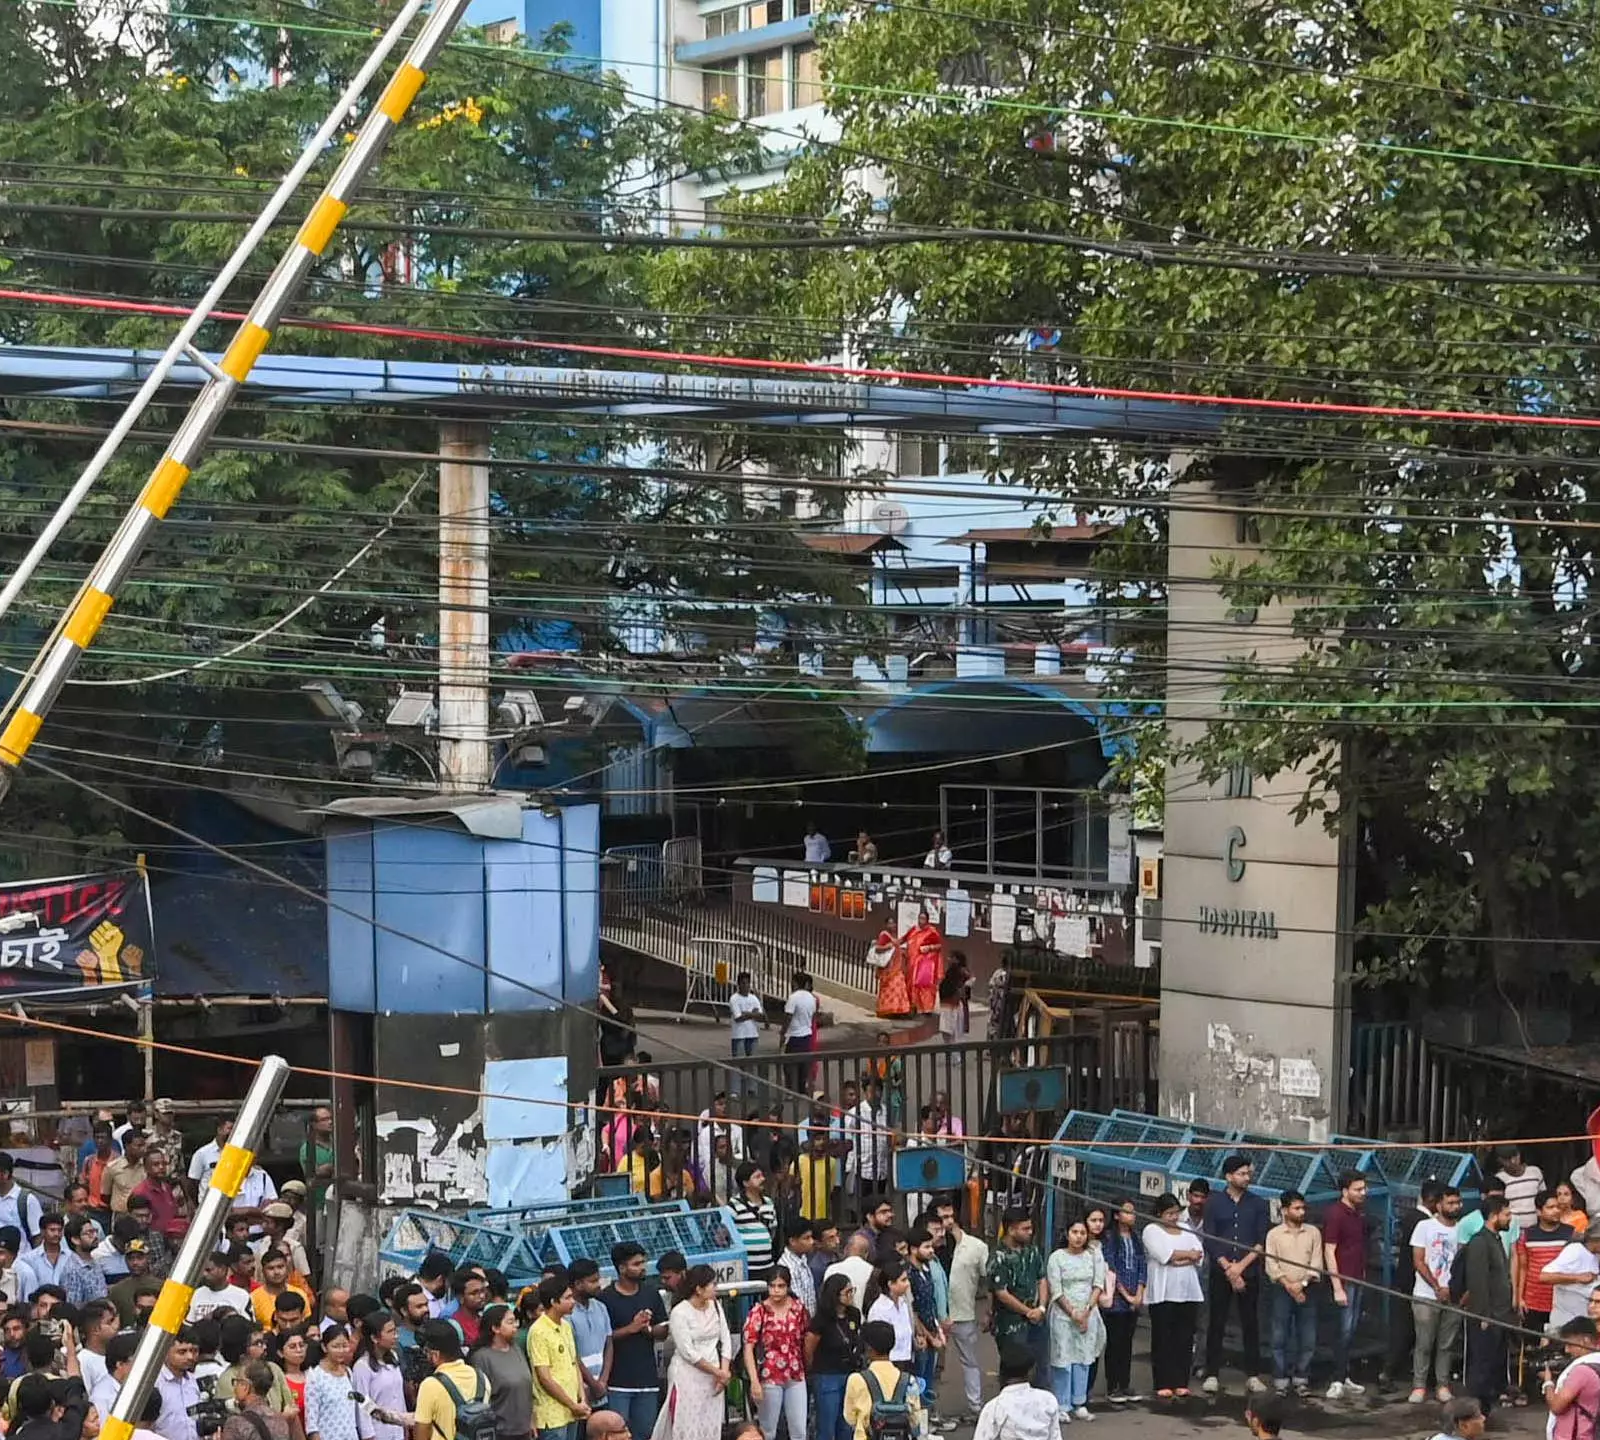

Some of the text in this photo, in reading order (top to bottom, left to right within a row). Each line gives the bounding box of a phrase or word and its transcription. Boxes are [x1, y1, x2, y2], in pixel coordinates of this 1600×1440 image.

[1225, 825, 1248, 882] C
[1199, 905, 1280, 939] HOSPITAL
[0, 928, 70, 970] চাই
[1056, 1159, 1072, 1171] KP
[1145, 1176, 1160, 1190] KP
[715, 1266, 735, 1283] KP
